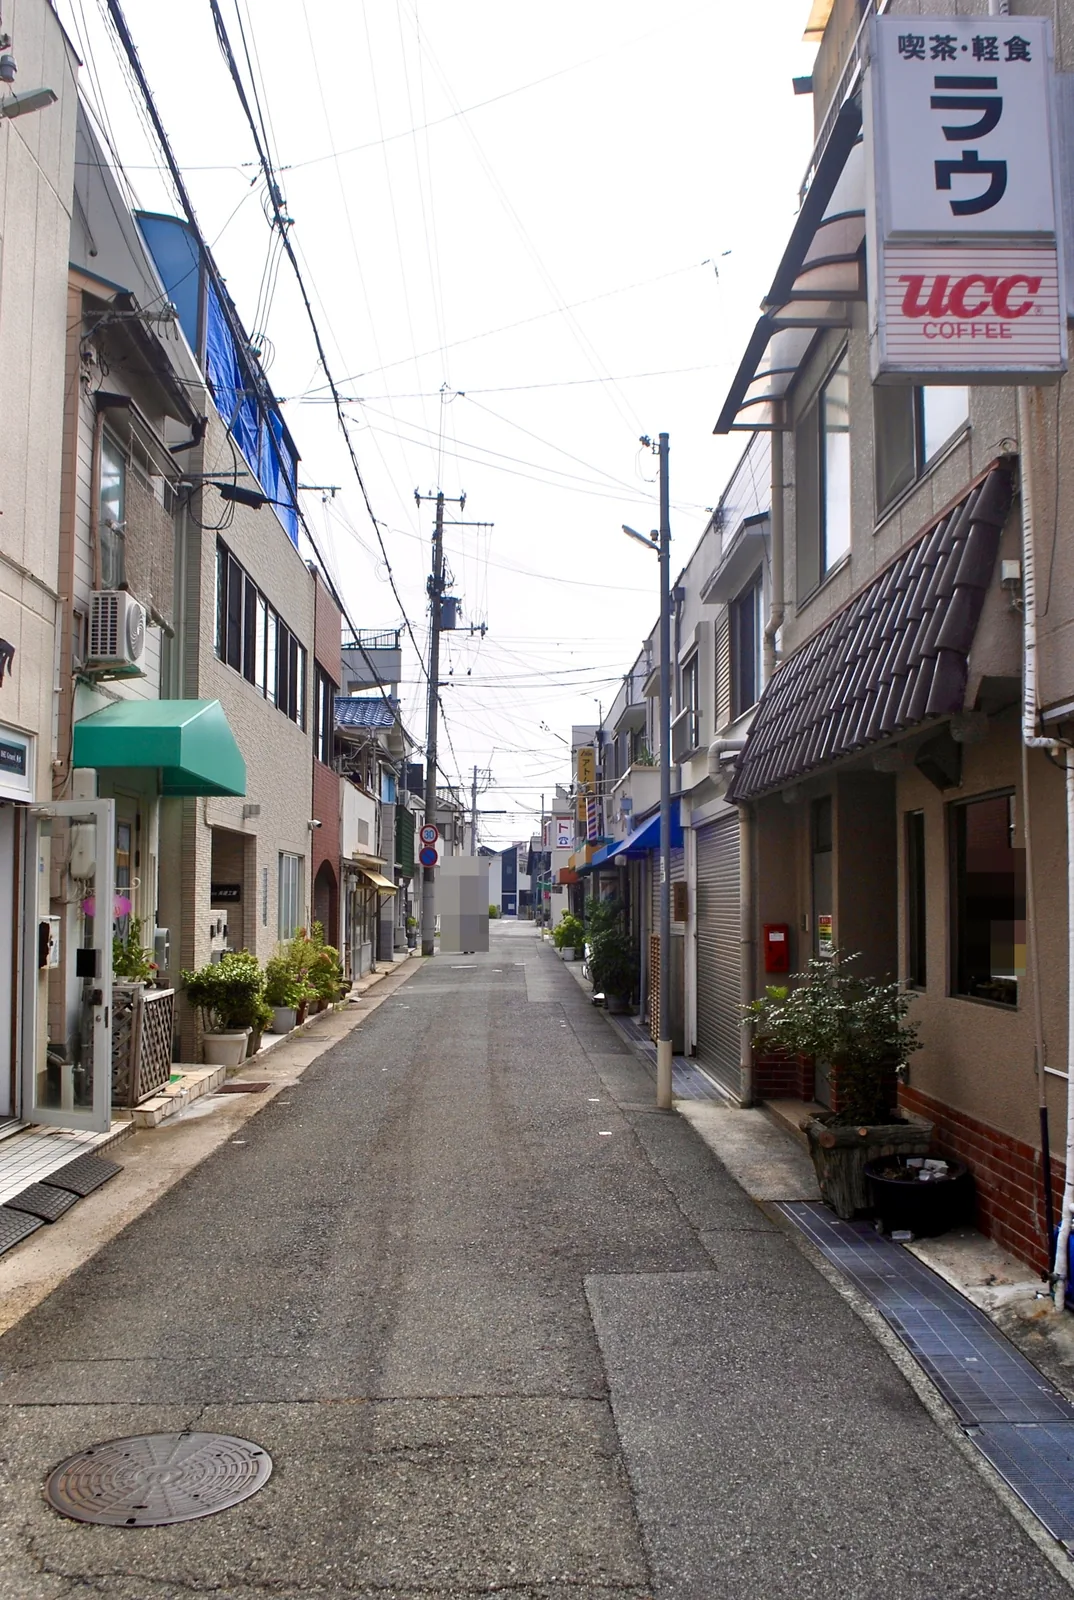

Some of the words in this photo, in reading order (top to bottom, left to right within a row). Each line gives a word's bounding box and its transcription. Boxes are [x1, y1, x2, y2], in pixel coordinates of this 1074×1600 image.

[897, 33, 1033, 62] 喫茶・軽食
[930, 75, 1007, 216] ラウ
[922, 321, 1013, 340] COFFEE
[424, 829, 435, 840] 30
